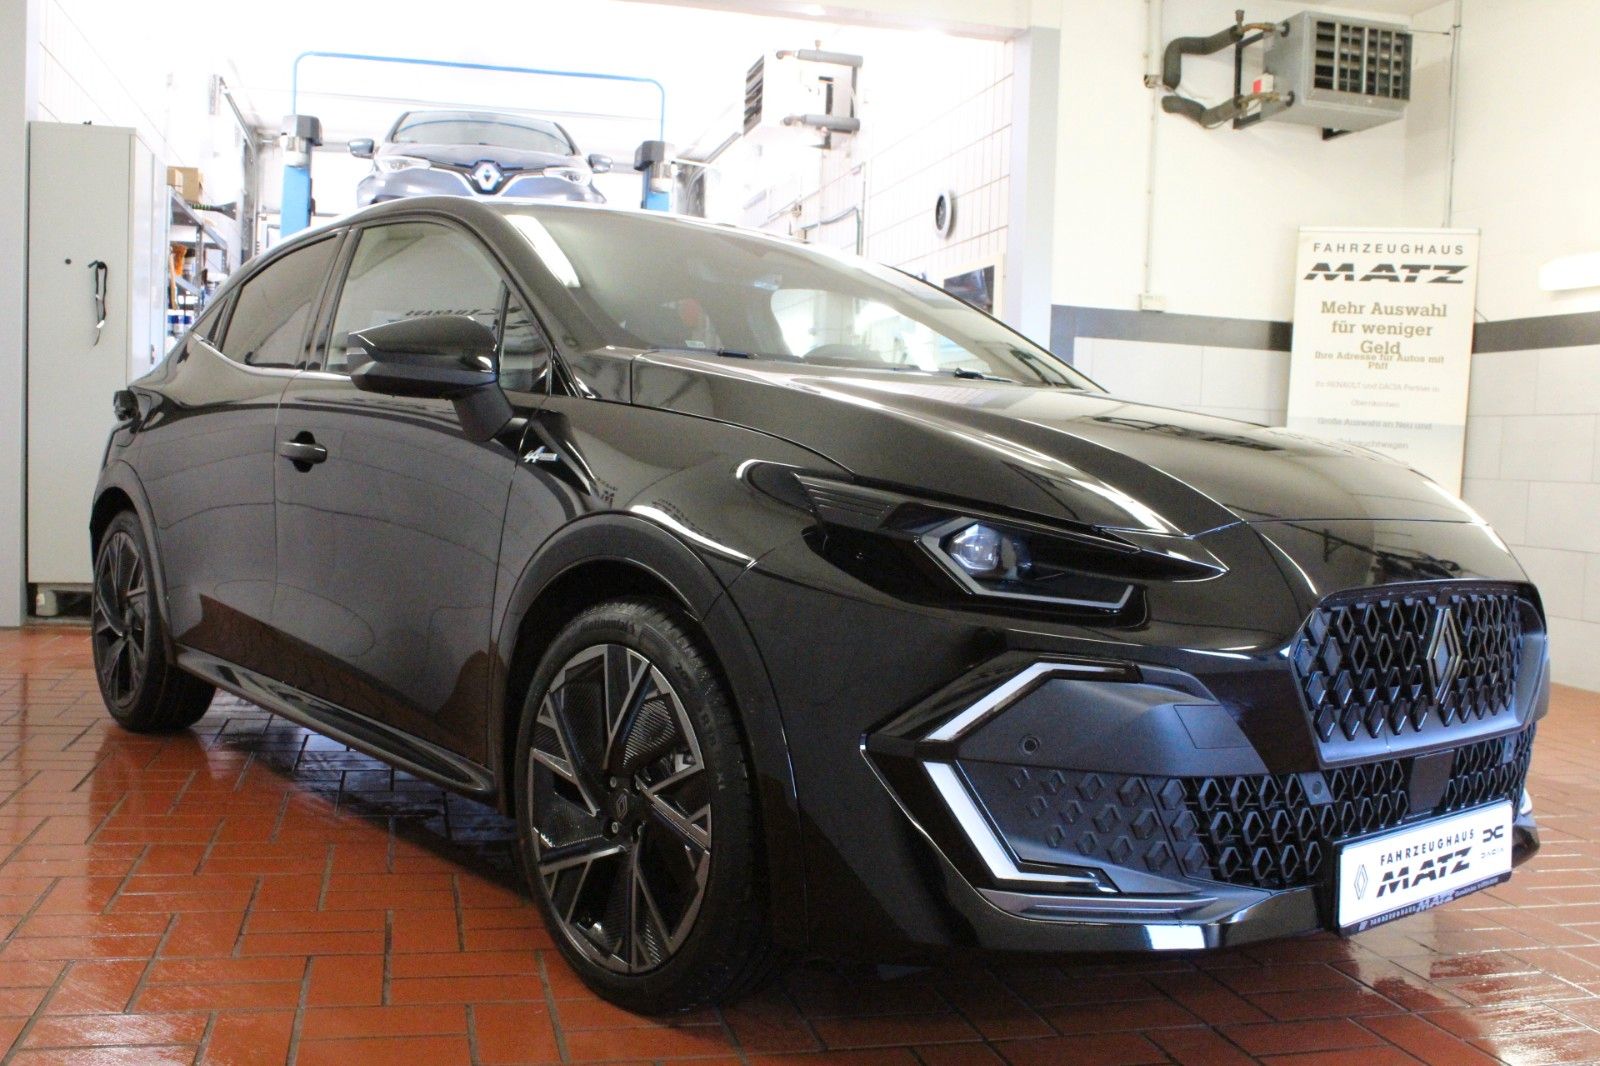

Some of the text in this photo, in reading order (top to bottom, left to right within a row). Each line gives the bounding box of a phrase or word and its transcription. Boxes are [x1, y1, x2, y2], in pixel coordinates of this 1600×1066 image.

[1313, 242, 1464, 255] FAHRZEUGHAUS
[1303, 262, 1469, 285] MATZ
[1320, 301, 1447, 317] Mehr Auswahl
[1331, 321, 1433, 338] für weniger
[1360, 341, 1401, 355] Geld
[1315, 351, 1334, 360] Ihre
[1336, 352, 1377, 361] Adresse
[1397, 355, 1426, 363] Autos
[1428, 356, 1445, 364] mit
[1380, 829, 1475, 866] FAHRZEUGHAUS
[1376, 846, 1472, 898] MATZ
